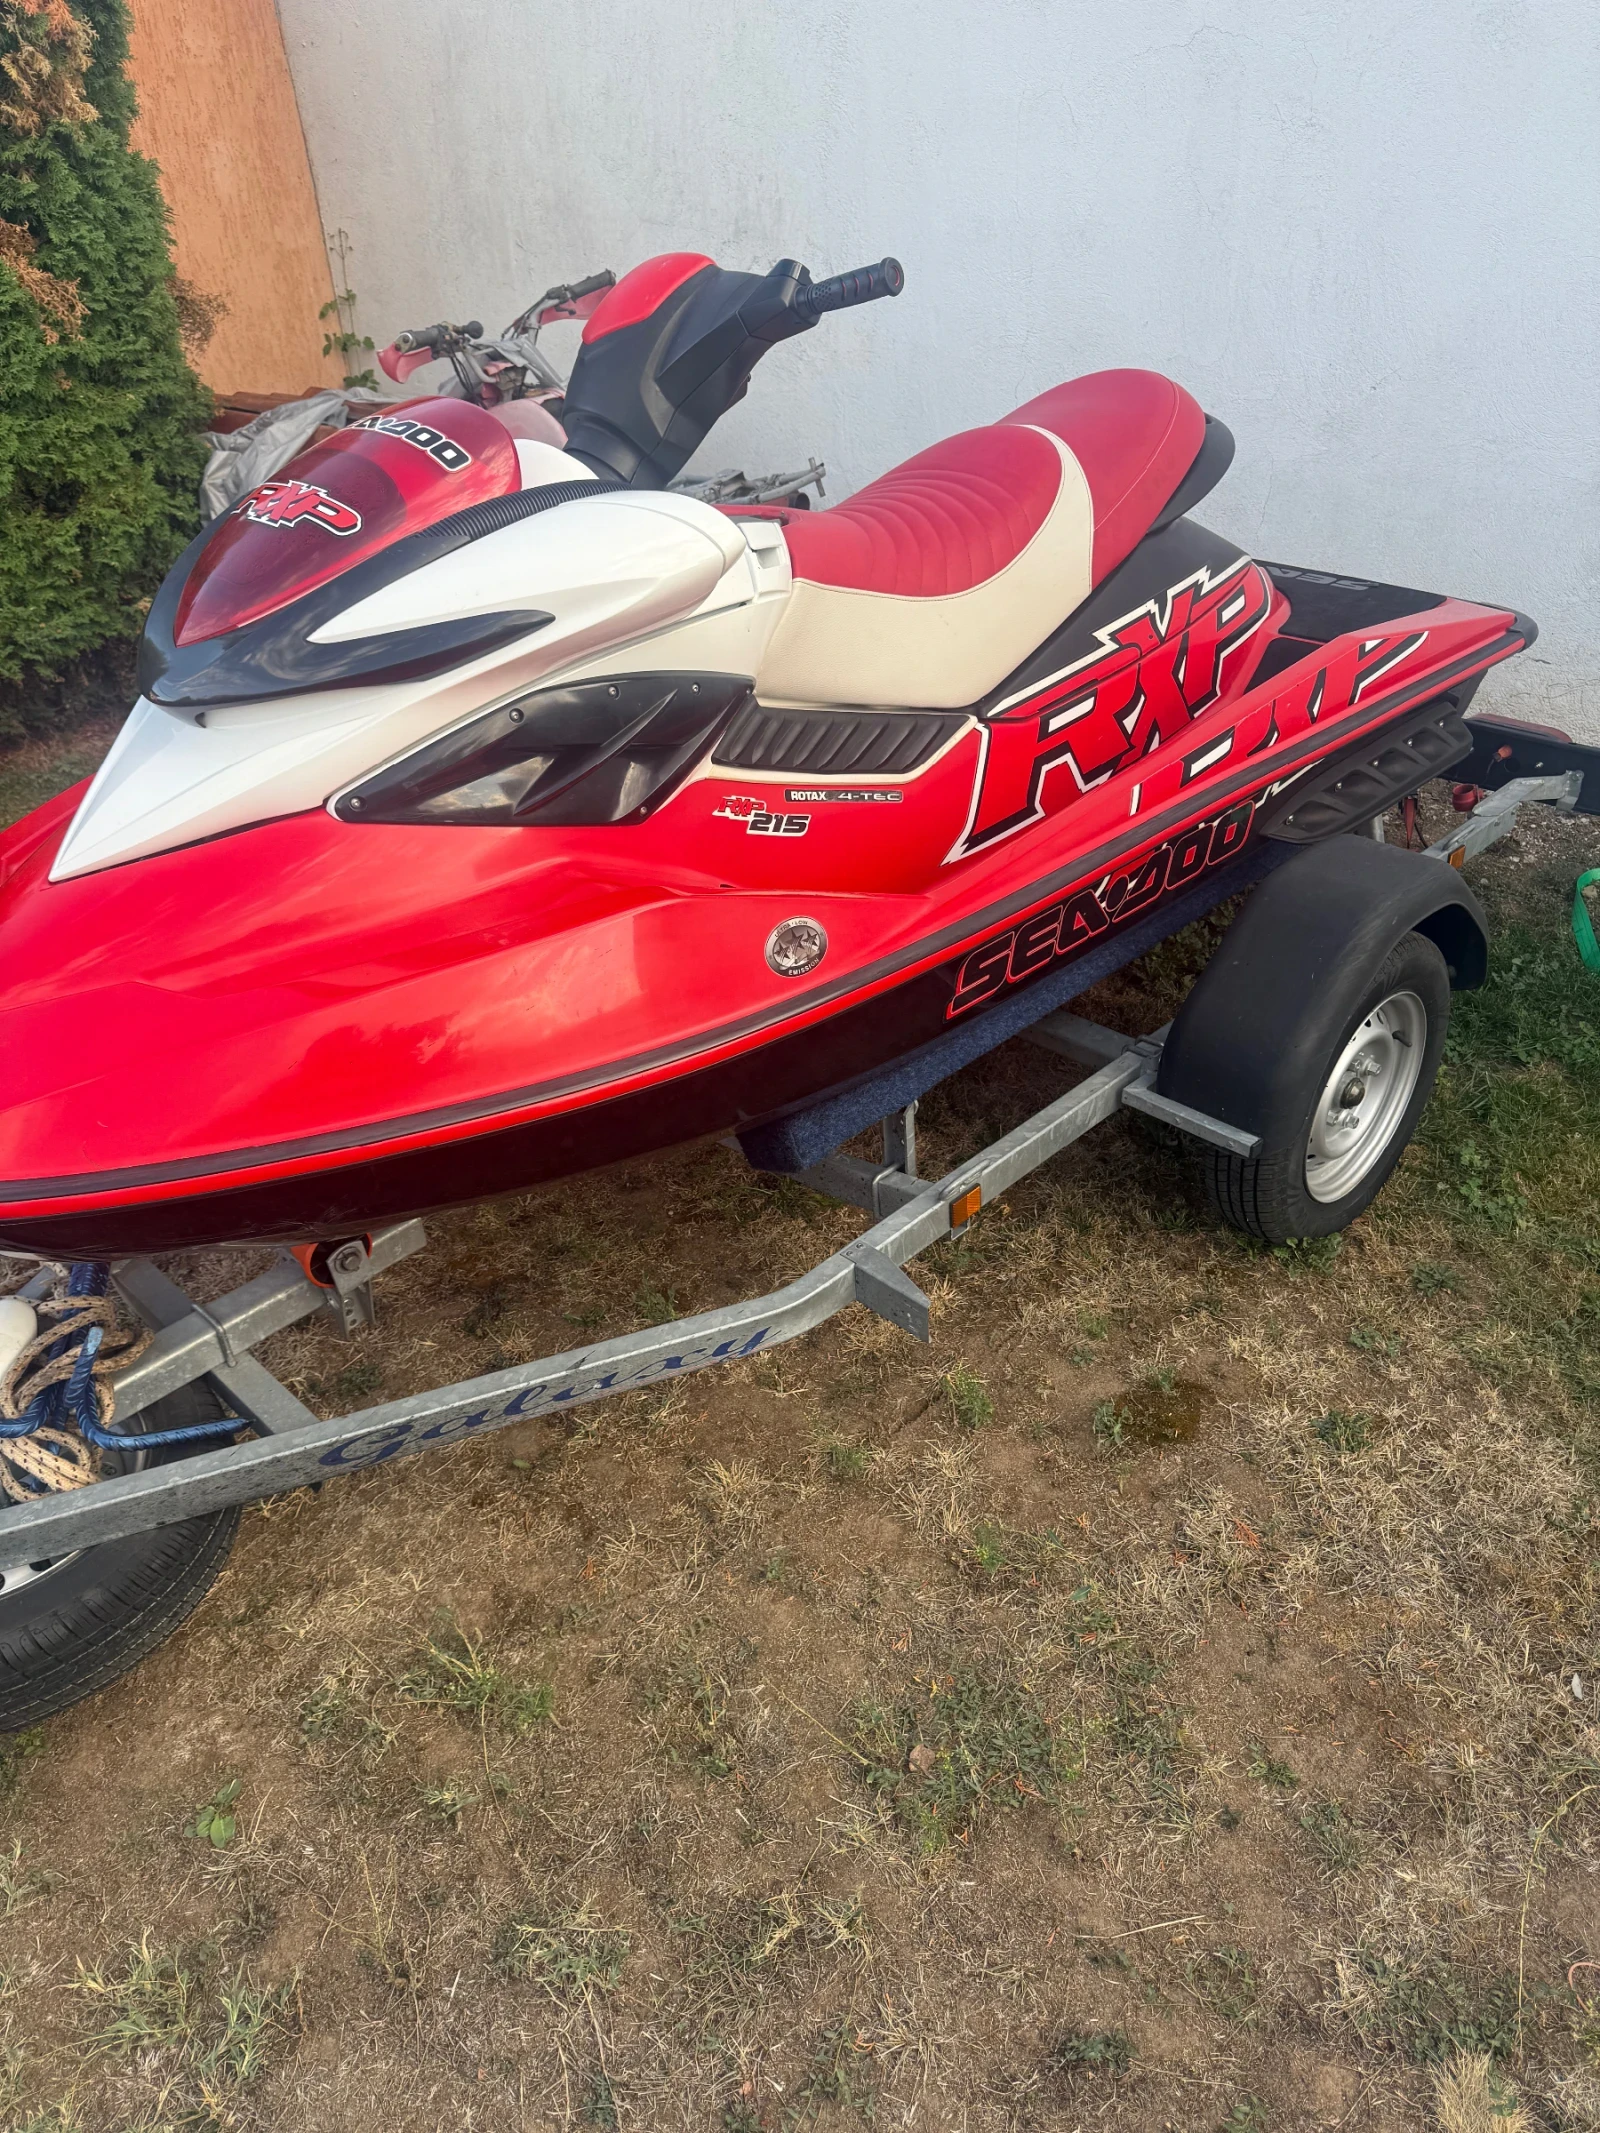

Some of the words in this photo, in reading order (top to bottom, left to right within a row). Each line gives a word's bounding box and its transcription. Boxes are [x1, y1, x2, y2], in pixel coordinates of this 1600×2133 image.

[231, 480, 362, 536] RXP
[952, 562, 1272, 856] RXP
[713, 795, 767, 819] RXP
[790, 790, 828, 801] ROTAX
[838, 792, 903, 801] 4-TEC
[748, 812, 811, 835] 215
[774, 923, 792, 938] ULTRA
[788, 957, 820, 976] EMISSION
[318, 1326, 783, 1469] Galaxy
